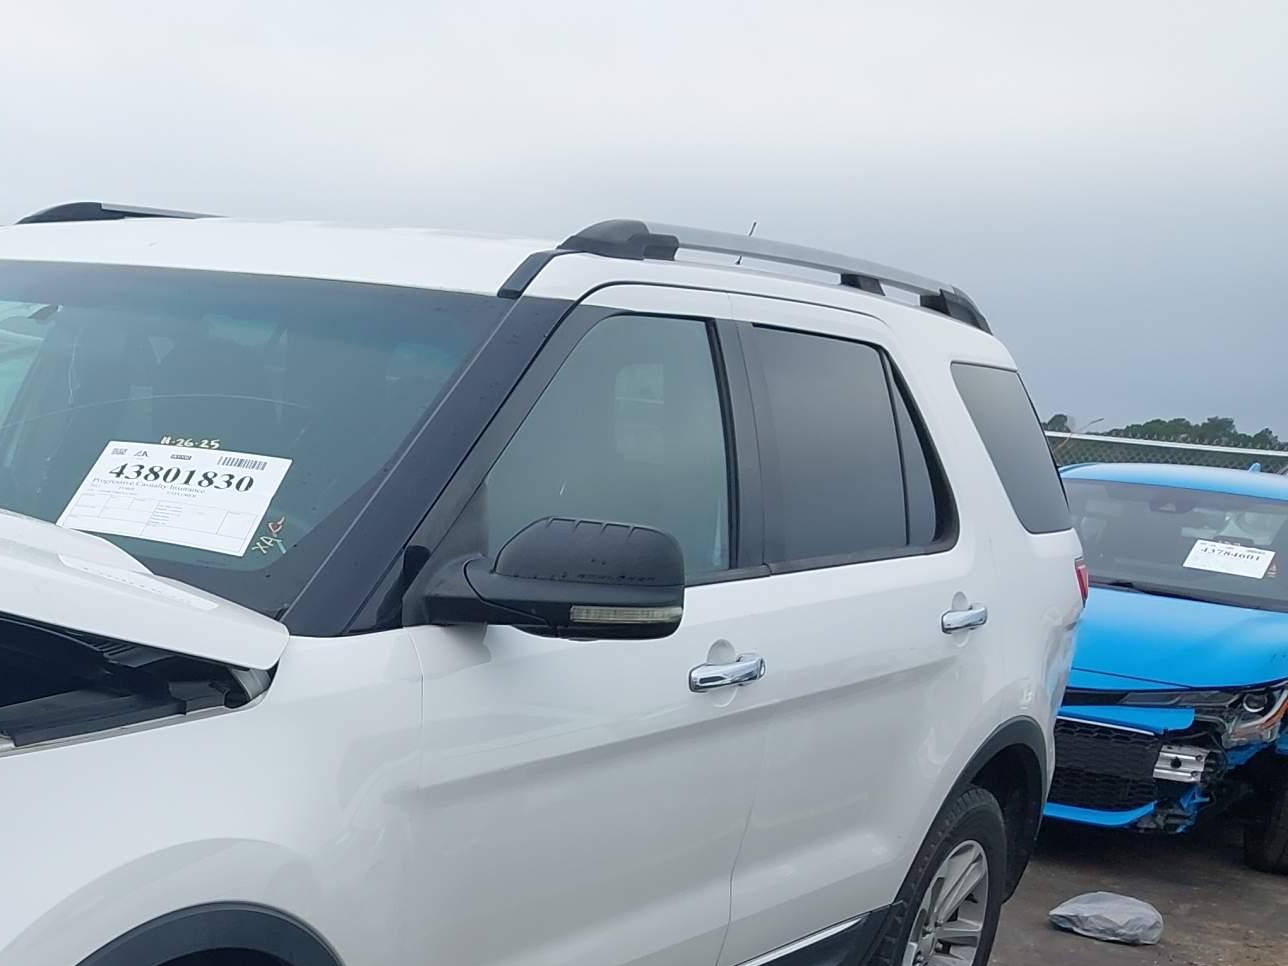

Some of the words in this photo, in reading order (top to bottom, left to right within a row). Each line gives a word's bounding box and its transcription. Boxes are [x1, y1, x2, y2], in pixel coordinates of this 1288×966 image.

[109, 462, 255, 493] 43801830
[136, 480, 168, 490] Casualty
[169, 484, 206, 494] Insurance
